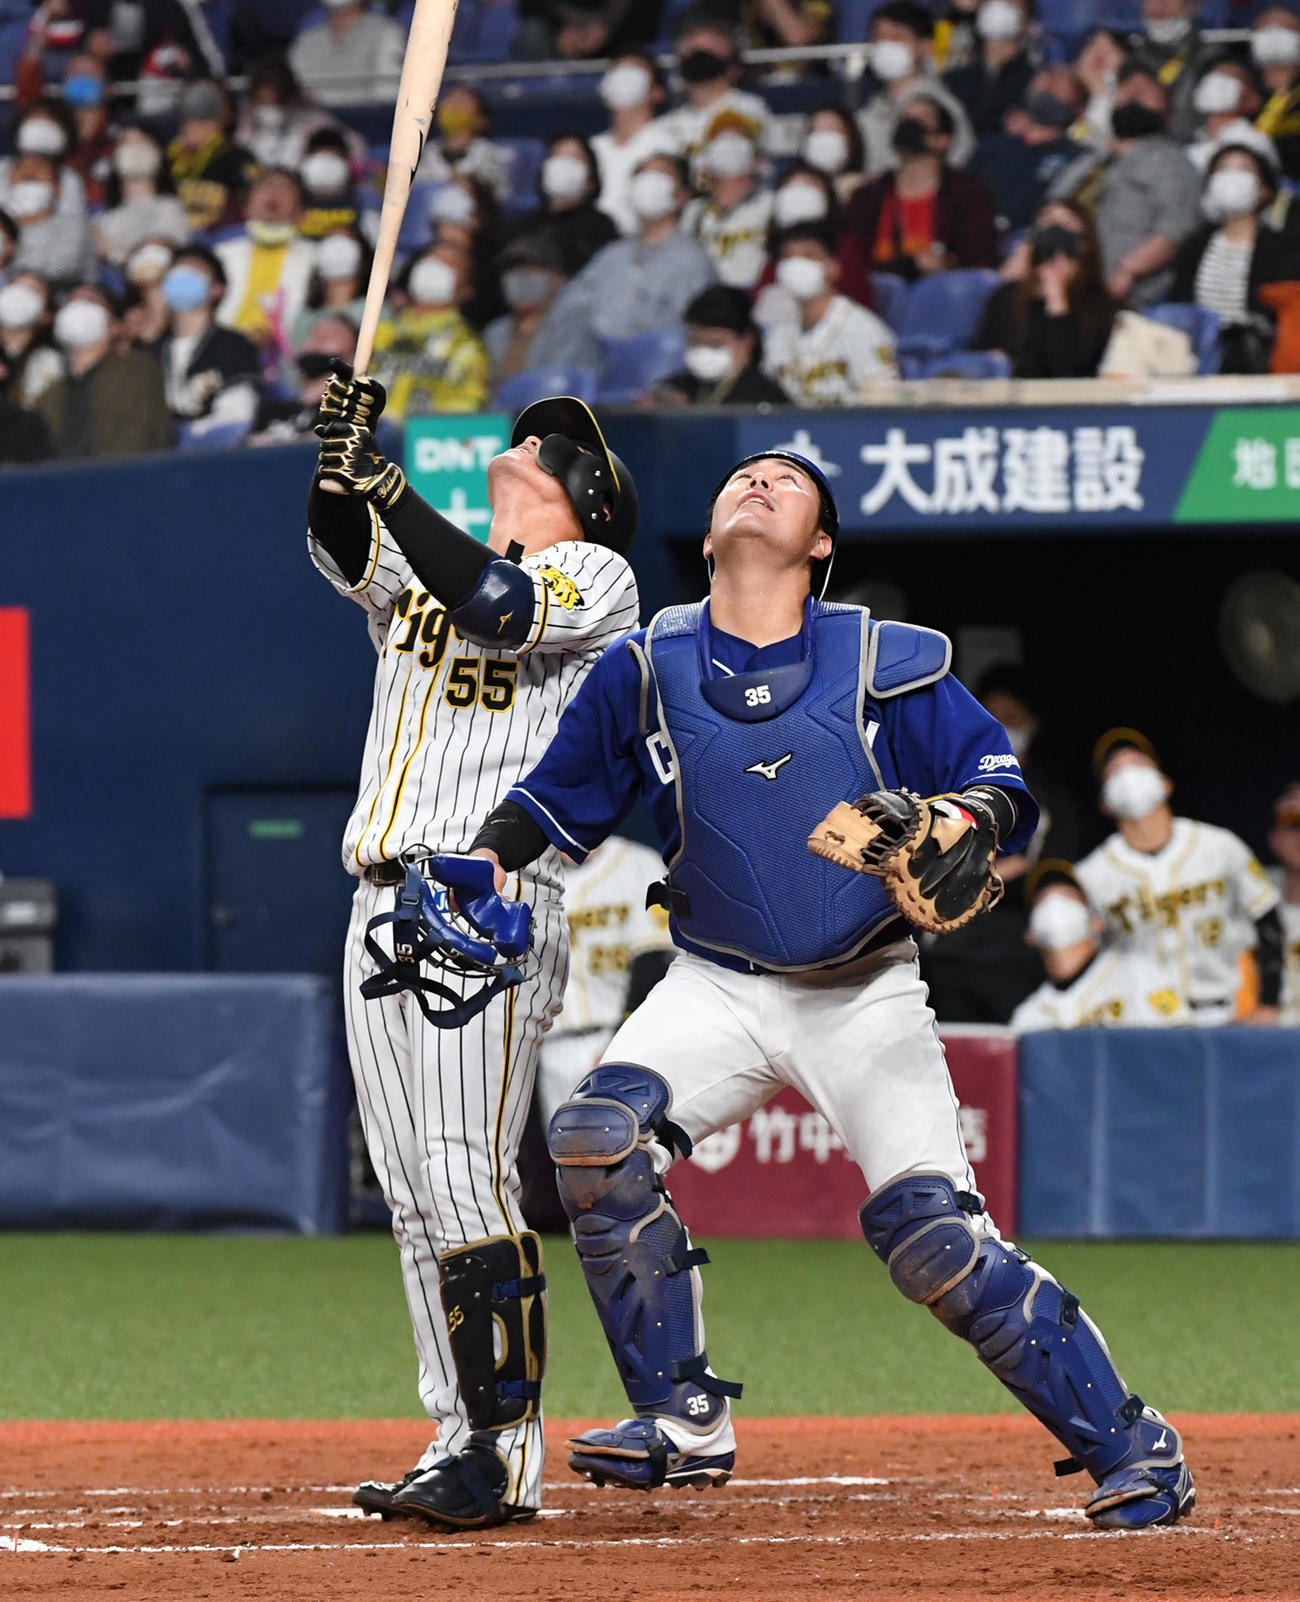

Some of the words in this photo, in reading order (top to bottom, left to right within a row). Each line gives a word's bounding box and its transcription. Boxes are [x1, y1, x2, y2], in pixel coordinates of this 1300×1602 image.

[859, 427, 1144, 515] 大成建設
[445, 655, 520, 714] 55
[744, 685, 772, 707] 35
[448, 1304, 465, 1333] 55
[686, 1393, 710, 1416] 35
